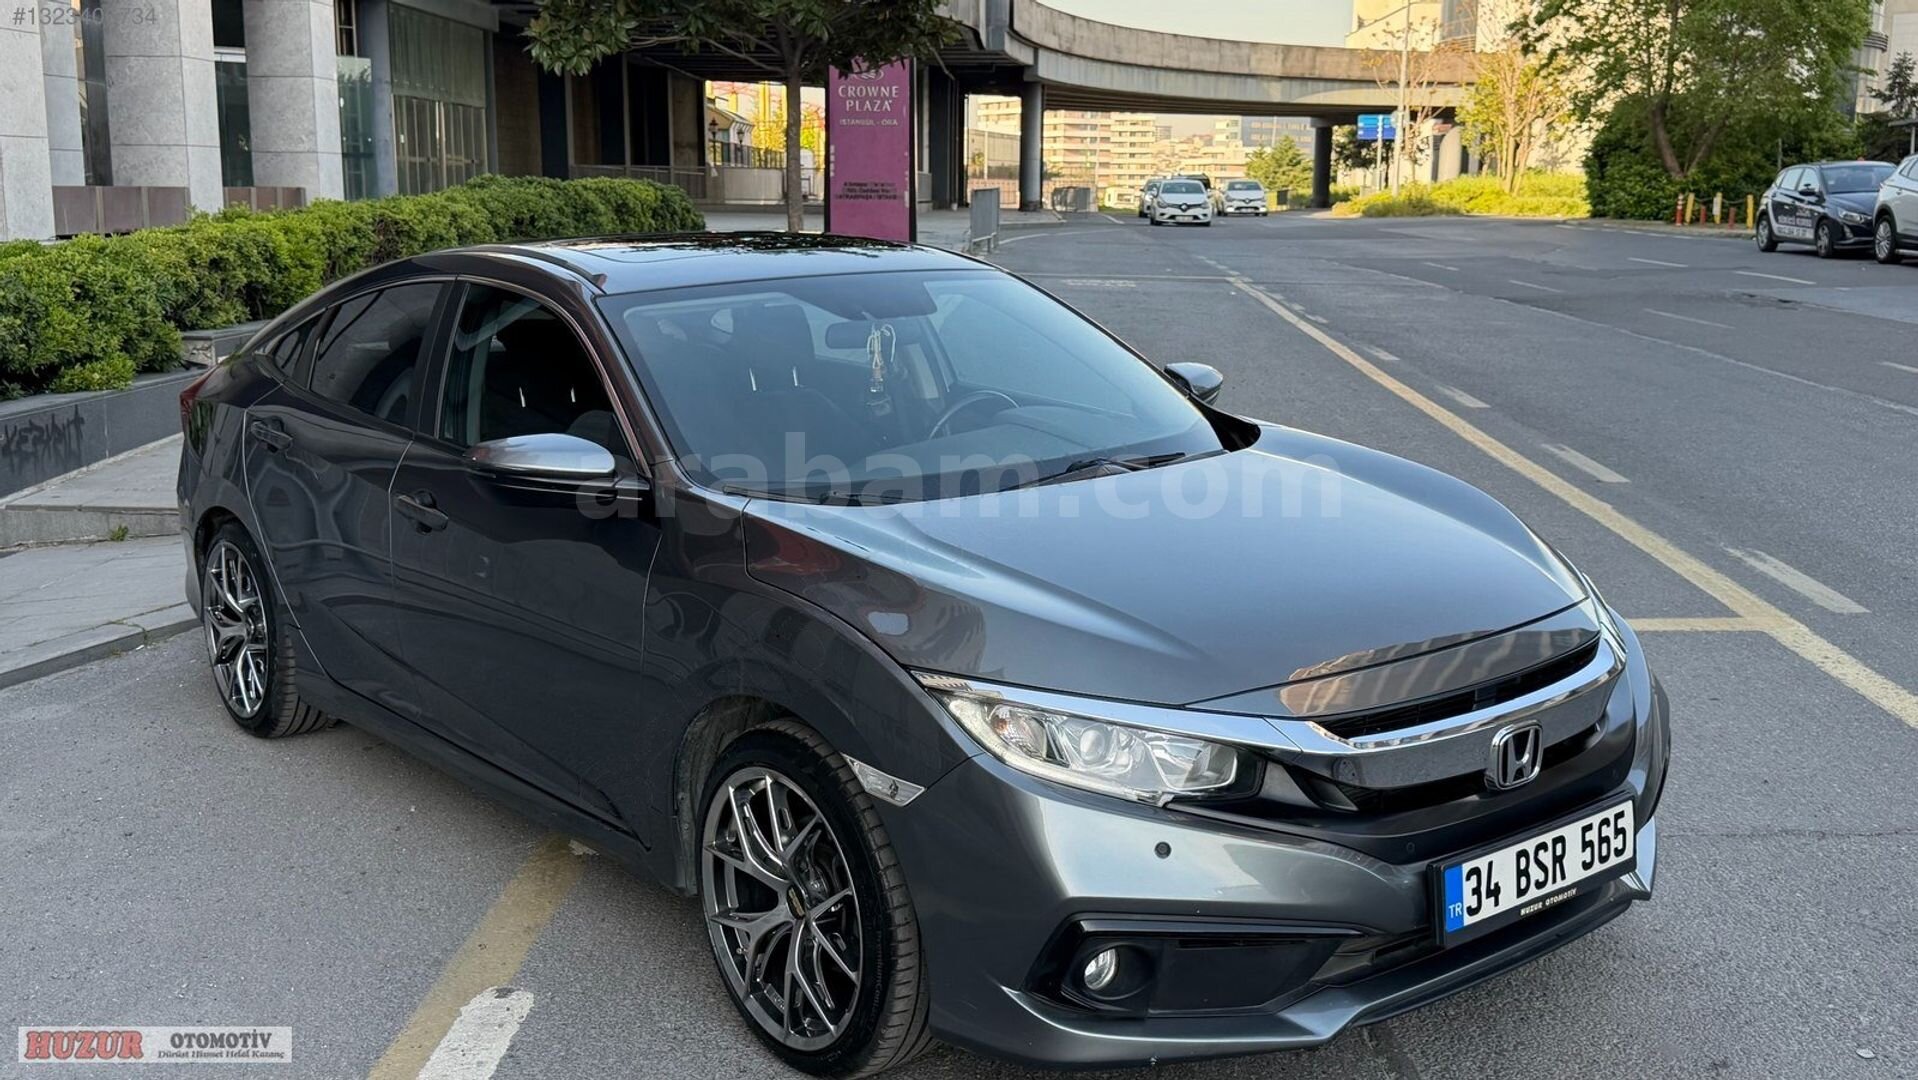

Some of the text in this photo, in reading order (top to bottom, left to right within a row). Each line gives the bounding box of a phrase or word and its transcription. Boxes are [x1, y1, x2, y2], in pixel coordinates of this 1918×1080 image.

[838, 85, 899, 98] CROWNE
[846, 101, 892, 112] PLAZA
[1465, 810, 1627, 917] 34 BSR 565
[1448, 902, 1462, 918] TR
